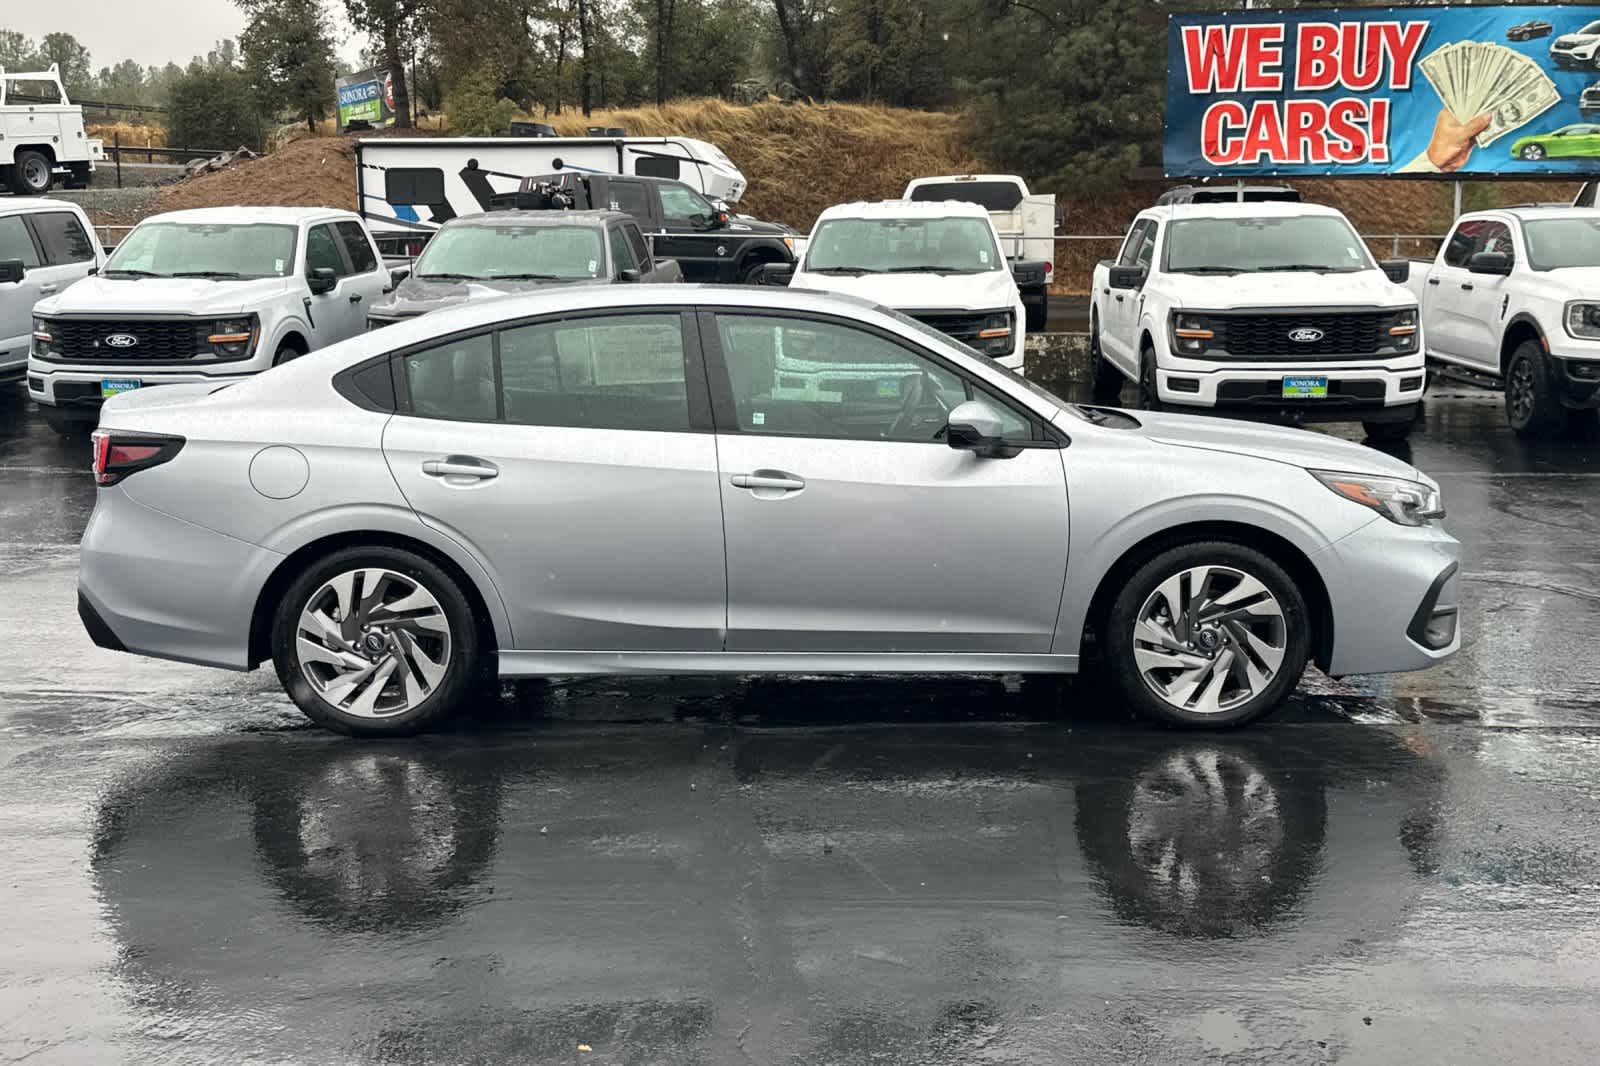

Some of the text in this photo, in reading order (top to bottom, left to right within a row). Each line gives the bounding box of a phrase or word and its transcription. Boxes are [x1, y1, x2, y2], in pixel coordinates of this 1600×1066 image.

[1181, 21, 1429, 93] WE BUY
[1202, 98, 1389, 165] CARS!
[109, 335, 133, 346] Ford
[1292, 329, 1319, 340] Ford
